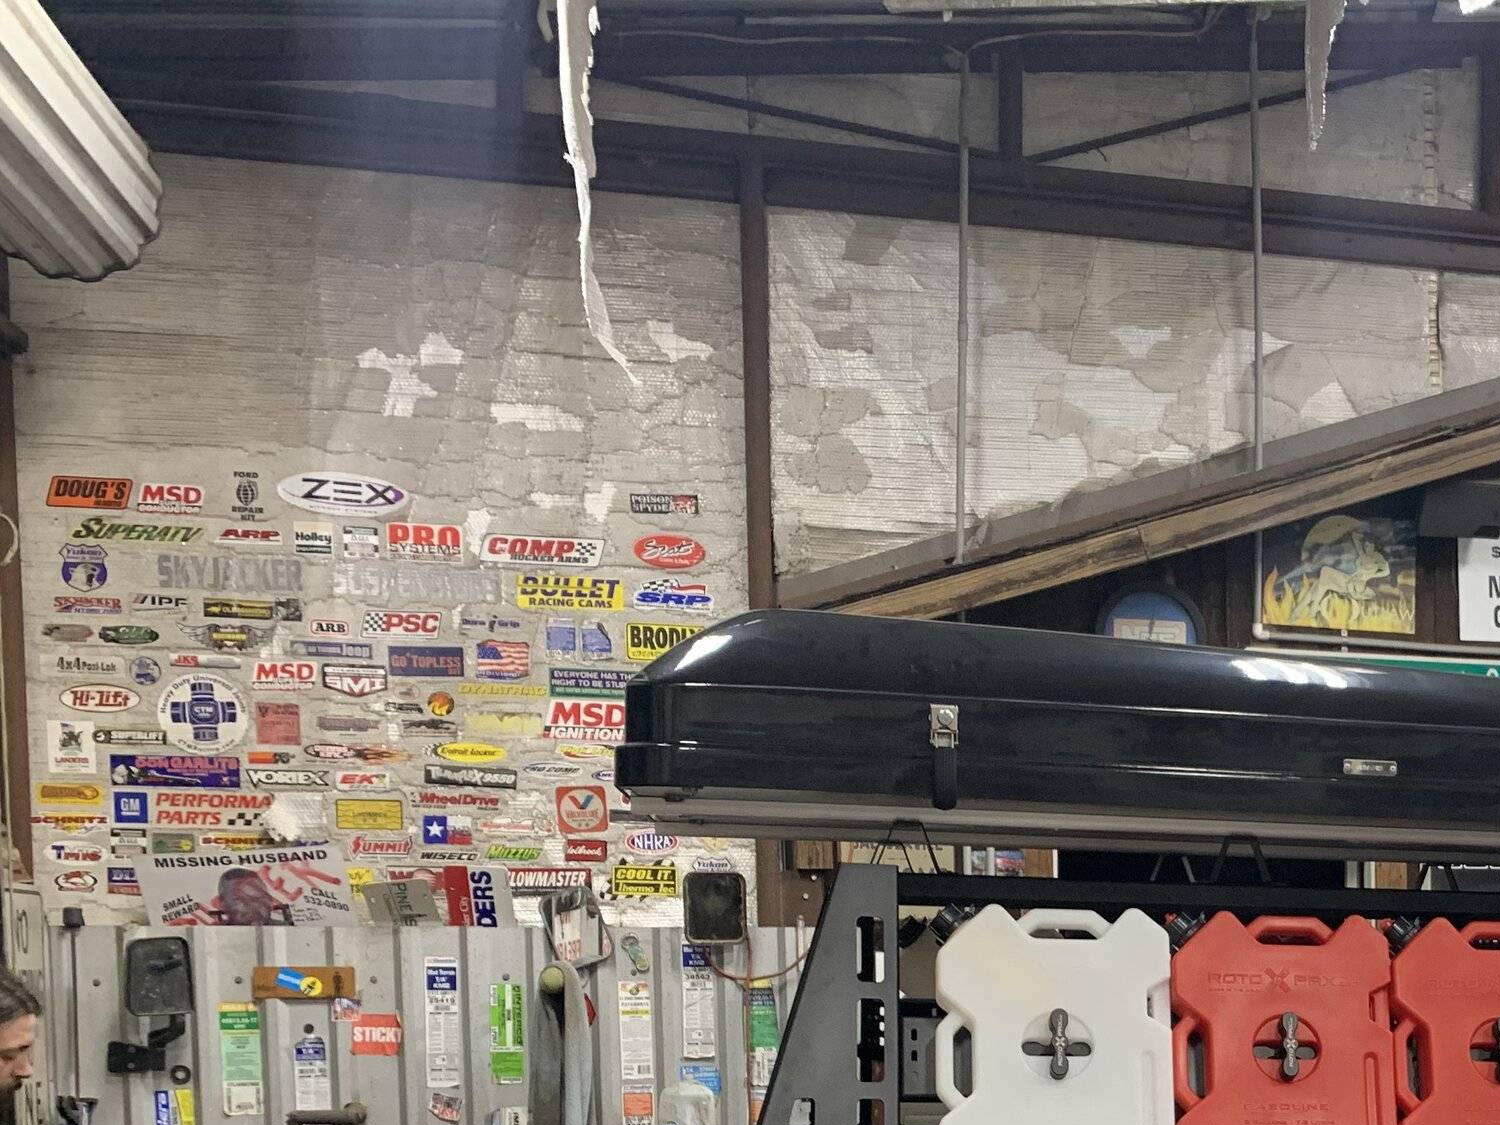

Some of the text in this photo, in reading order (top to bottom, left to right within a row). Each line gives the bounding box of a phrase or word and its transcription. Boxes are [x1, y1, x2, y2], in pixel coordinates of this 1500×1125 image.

[233, 471, 259, 479] FORD
[54, 478, 127, 500] DOUG'S
[141, 485, 203, 504] MSD
[301, 477, 397, 505] ZEX
[630, 494, 673, 504] POISON
[231, 506, 264, 514] REPAIR
[219, 528, 281, 540] ARP
[295, 531, 332, 545] Holley
[387, 523, 461, 546] PRO
[388, 543, 461, 555] SYSTEMS
[487, 536, 575, 557] COMP
[509, 554, 589, 564] ROCKER ARMS
[156, 554, 303, 593] SKYJACKER
[519, 575, 621, 599] BULLET
[528, 598, 613, 609] RACING CAMS
[635, 591, 713, 606] SRP
[315, 623, 346, 633] ARB
[384, 614, 440, 633] PSC
[56, 656, 82, 671] 4x4
[173, 655, 200, 667] JKS
[391, 655, 461, 670] GO TOPLESS
[255, 663, 315, 681] MSD
[553, 670, 631, 681] EVERYONE HAS TH
[551, 679, 627, 689] RIGHT TO BE STUP
[69, 689, 131, 707] Hi-Lift
[550, 701, 626, 727] MSD
[550, 726, 624, 740] IGNITION
[523, 765, 581, 774] PRO COMP
[246, 769, 330, 788] VORTEX
[120, 798, 140, 812] GM
[156, 792, 273, 809] PERFORMA
[156, 811, 221, 825] PARTS
[633, 834, 672, 850] NHRA
[154, 849, 328, 868] MISSING HUSBAND
[419, 851, 479, 862] WISECO
[508, 871, 587, 887] LOWMASTER
[615, 868, 655, 880] COOL
[310, 886, 338, 901] CALL
[616, 882, 675, 894] Thermo Tec
[162, 893, 194, 912] SMALL
[391, 882, 414, 914] PINE
[161, 902, 201, 923] REWARD
[353, 1026, 401, 1042] STICKY
